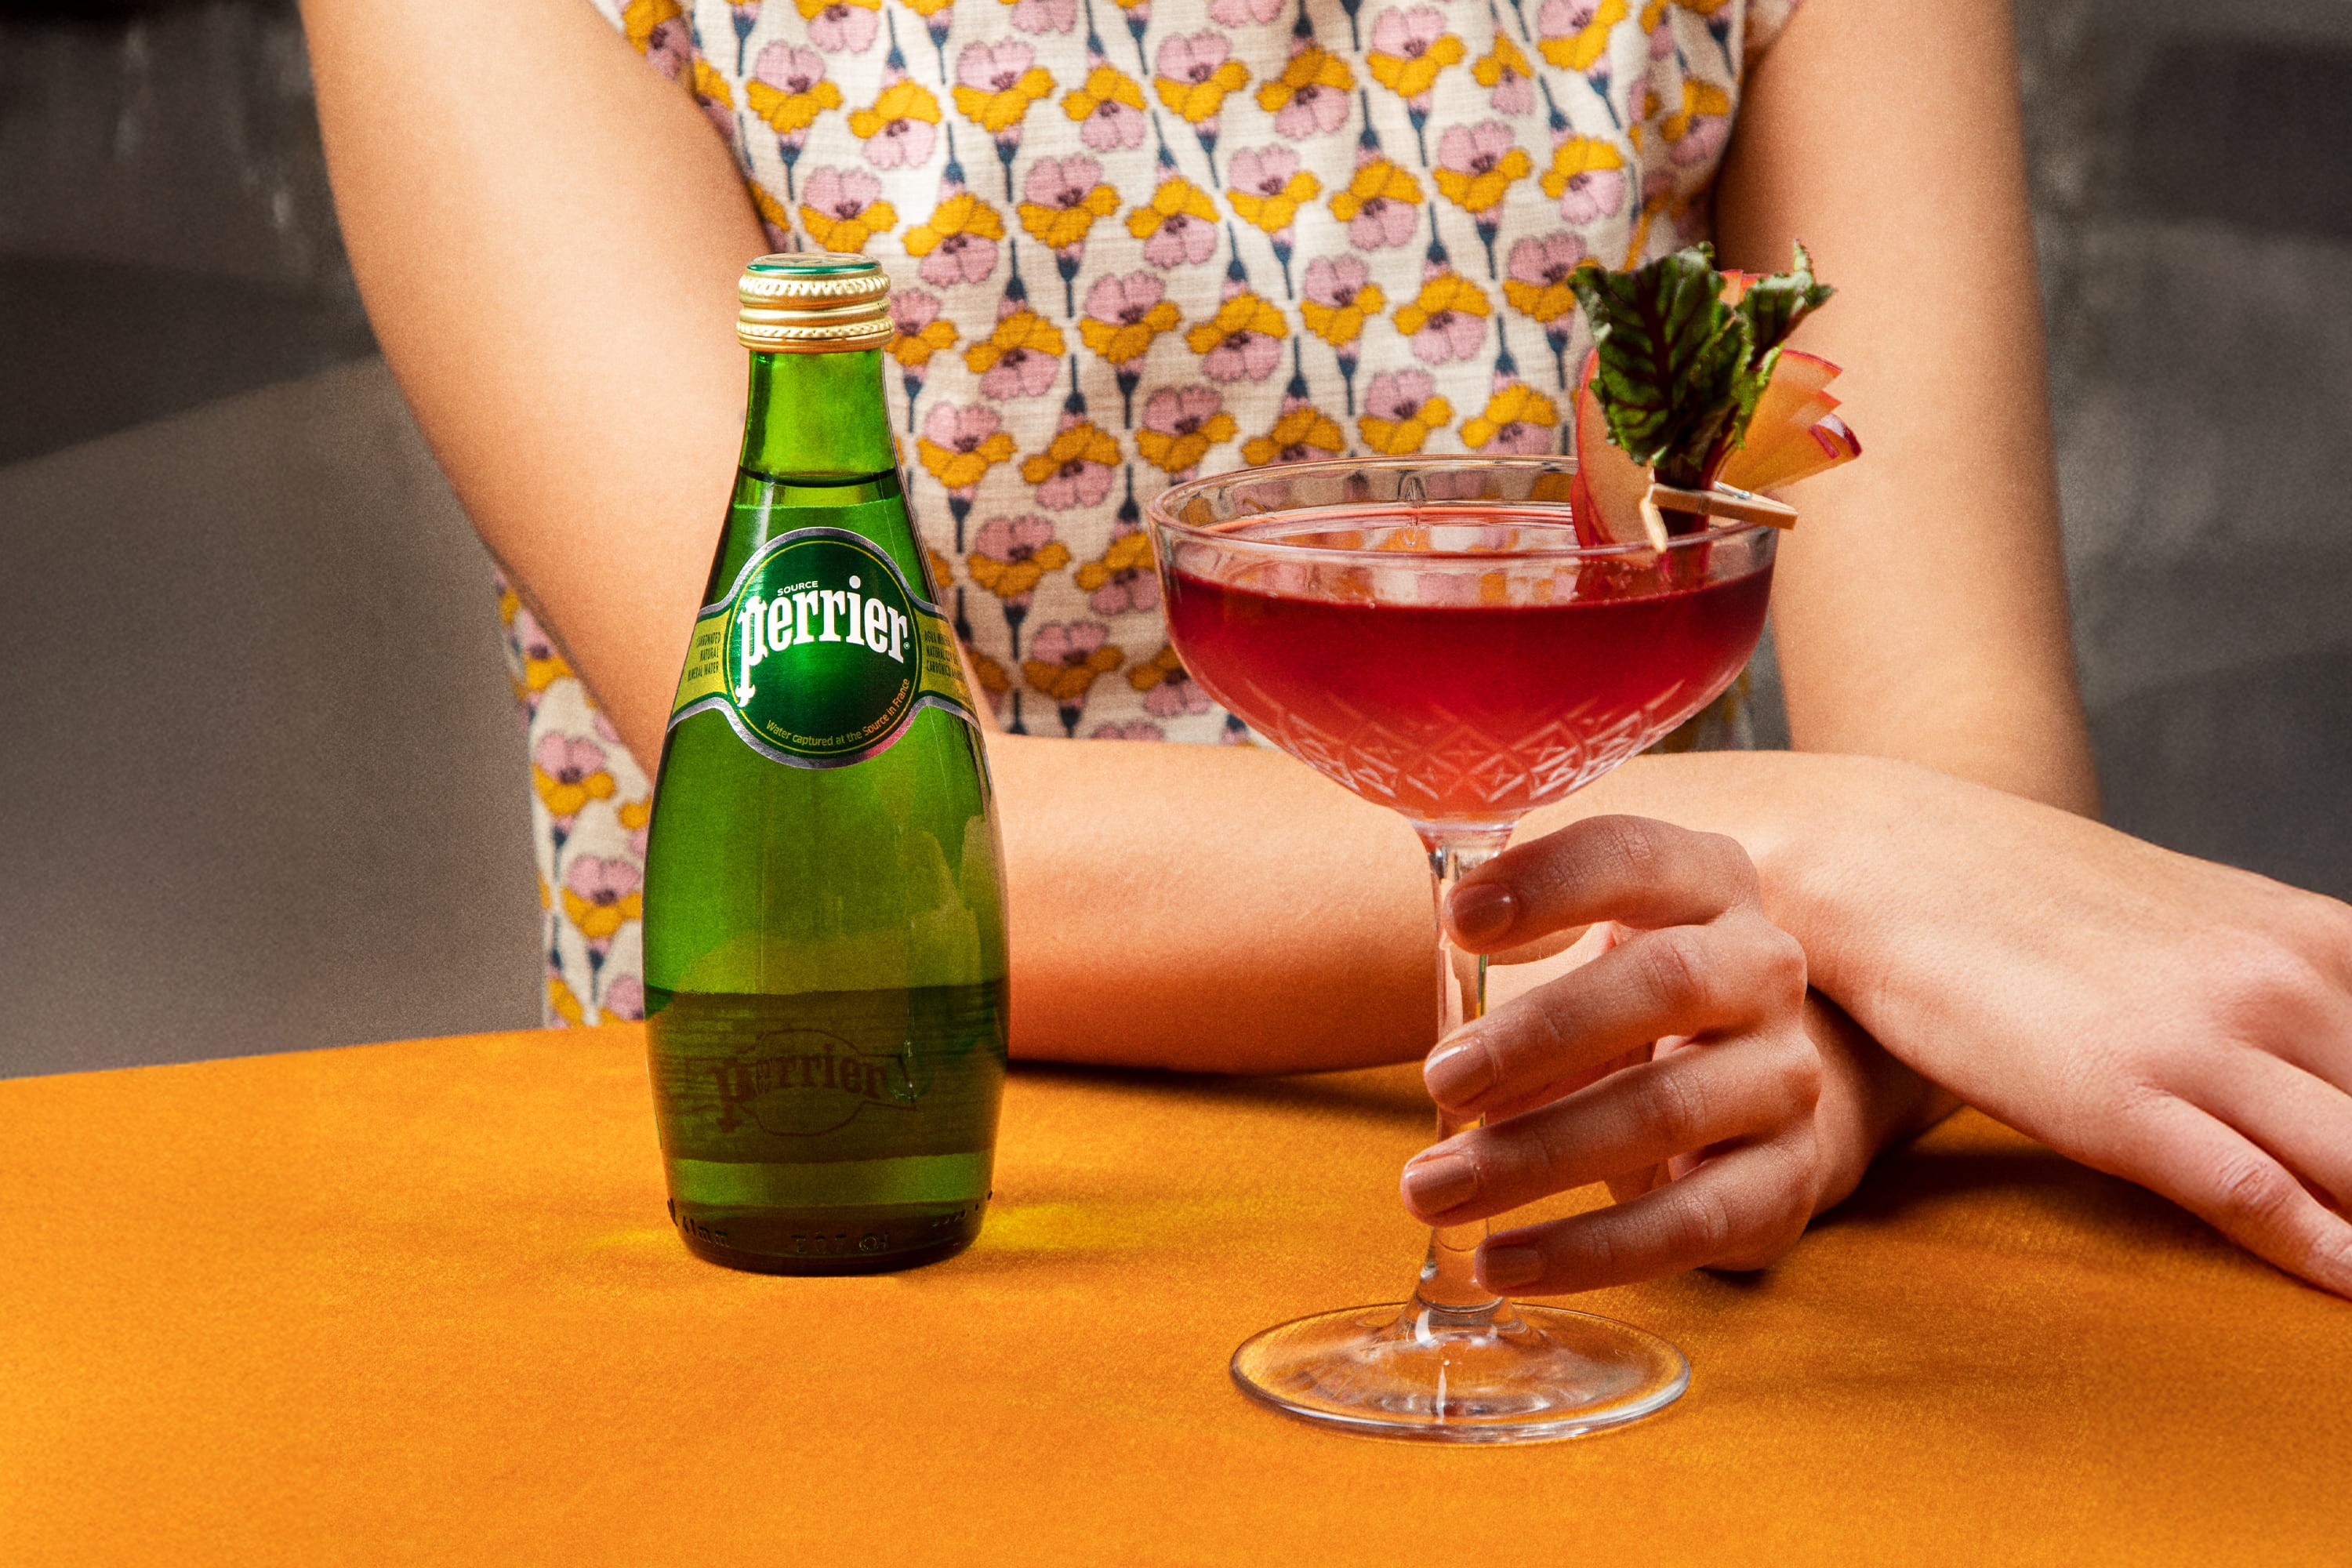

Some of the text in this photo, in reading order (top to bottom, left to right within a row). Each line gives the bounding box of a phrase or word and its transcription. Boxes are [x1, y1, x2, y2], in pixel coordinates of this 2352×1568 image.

[777, 580, 818, 597] SOURCE
[765, 678, 910, 746] Water captured at the Source in France
